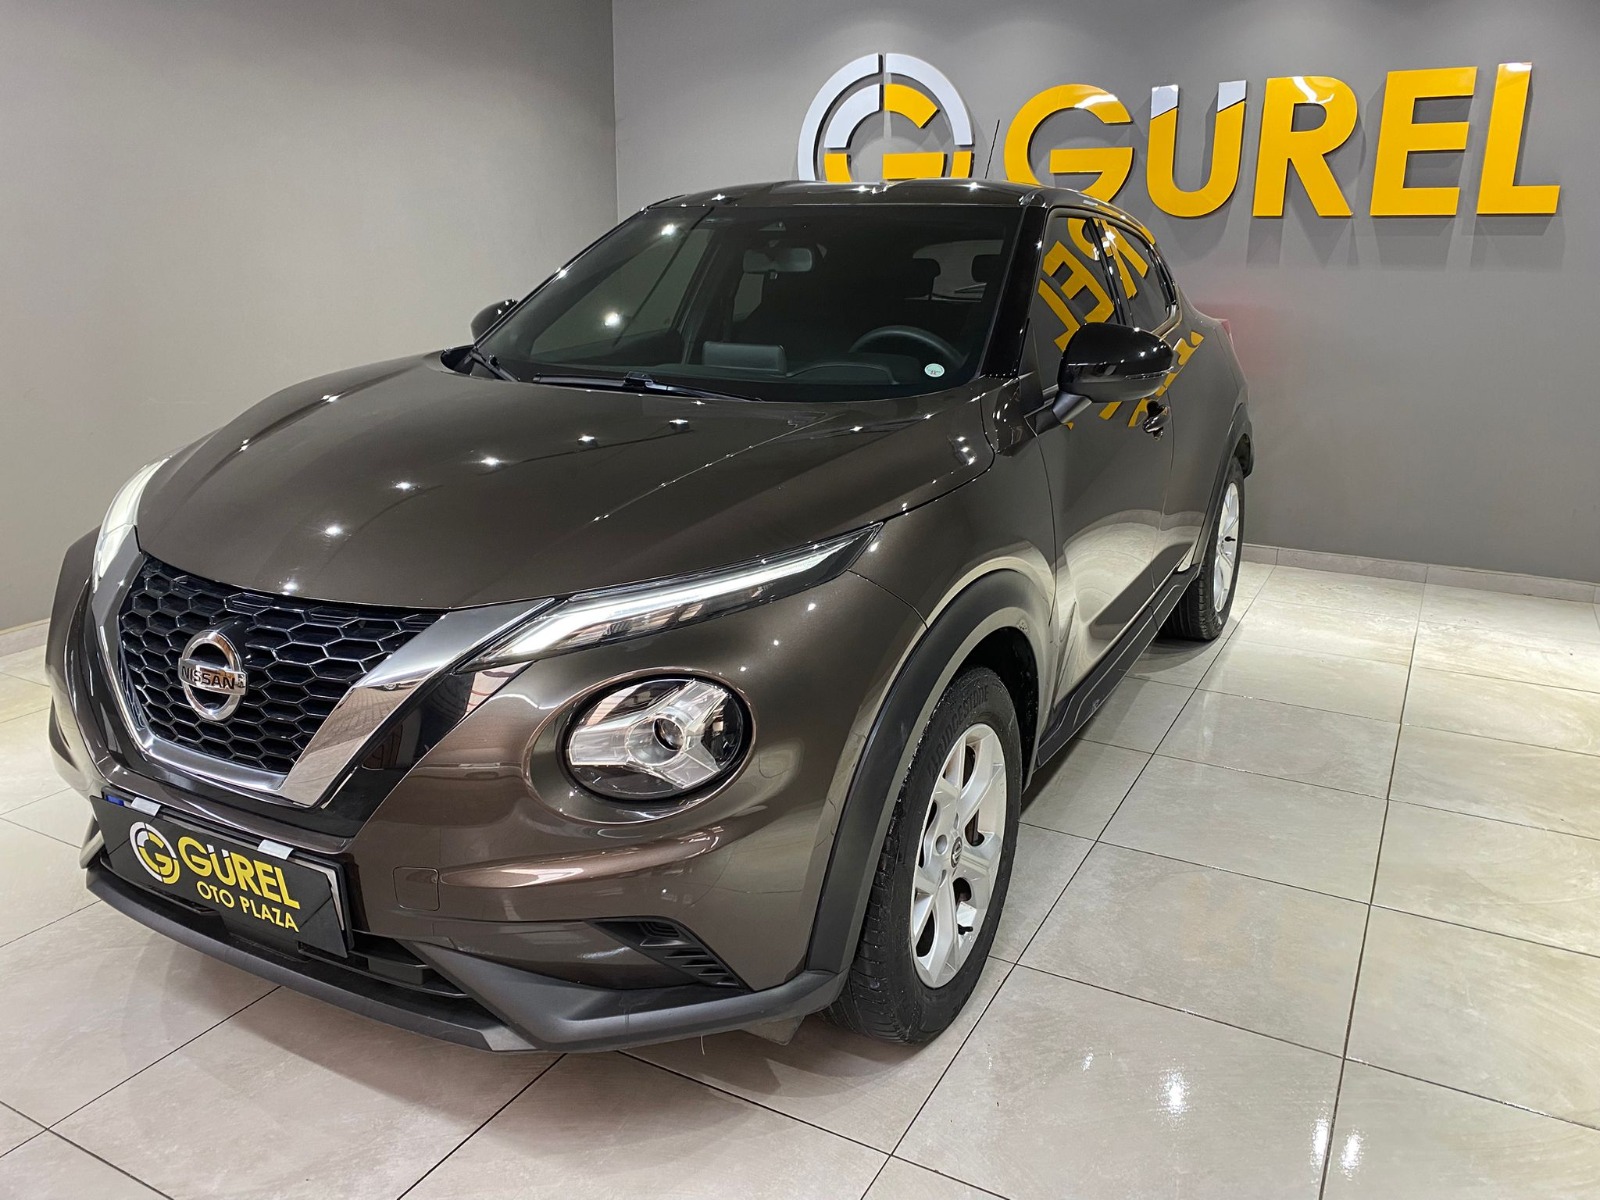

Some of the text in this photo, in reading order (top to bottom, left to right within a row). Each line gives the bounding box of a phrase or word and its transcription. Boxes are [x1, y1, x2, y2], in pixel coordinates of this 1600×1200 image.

[181, 665, 236, 690] NISSAN
[196, 880, 300, 933] OTO PLAZA
